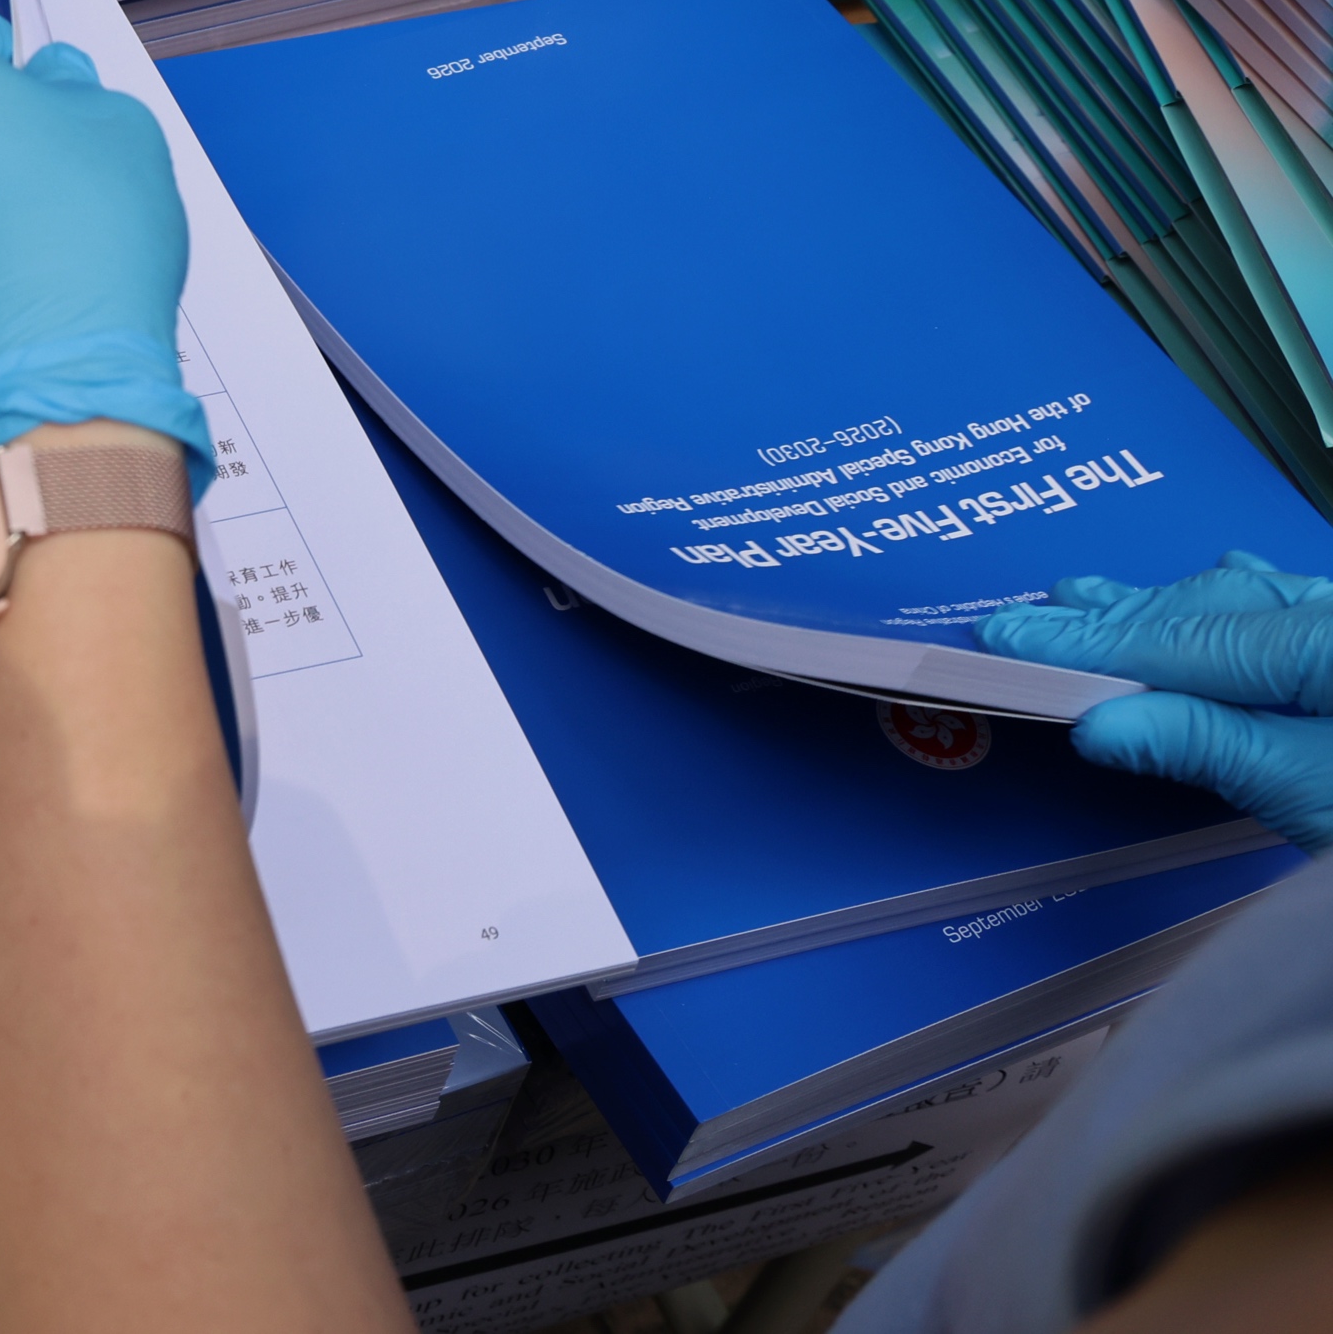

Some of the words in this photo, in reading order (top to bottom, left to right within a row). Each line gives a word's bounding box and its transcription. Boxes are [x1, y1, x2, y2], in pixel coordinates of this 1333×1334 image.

[477, 33, 568, 64] September
[426, 58, 475, 80] 2026
[1027, 401, 1069, 421] the
[1067, 393, 1091, 413] of
[969, 411, 1032, 440] Hong
[909, 423, 974, 466] Kong
[1032, 435, 1067, 454] for
[837, 448, 911, 481] Special
[929, 446, 1033, 485] Economic
[1064, 449, 1165, 491] The
[688, 468, 838, 511] Administrative
[825, 486, 889, 515] Social
[886, 475, 929, 501] and
[958, 474, 1078, 525] First
[616, 496, 690, 515] Region
[691, 498, 828, 531] Development
[775, 504, 974, 558] Five-Year
[669, 540, 782, 569] Plan
[243, 605, 324, 636] 進一步優
[480, 925, 500, 942] 49
